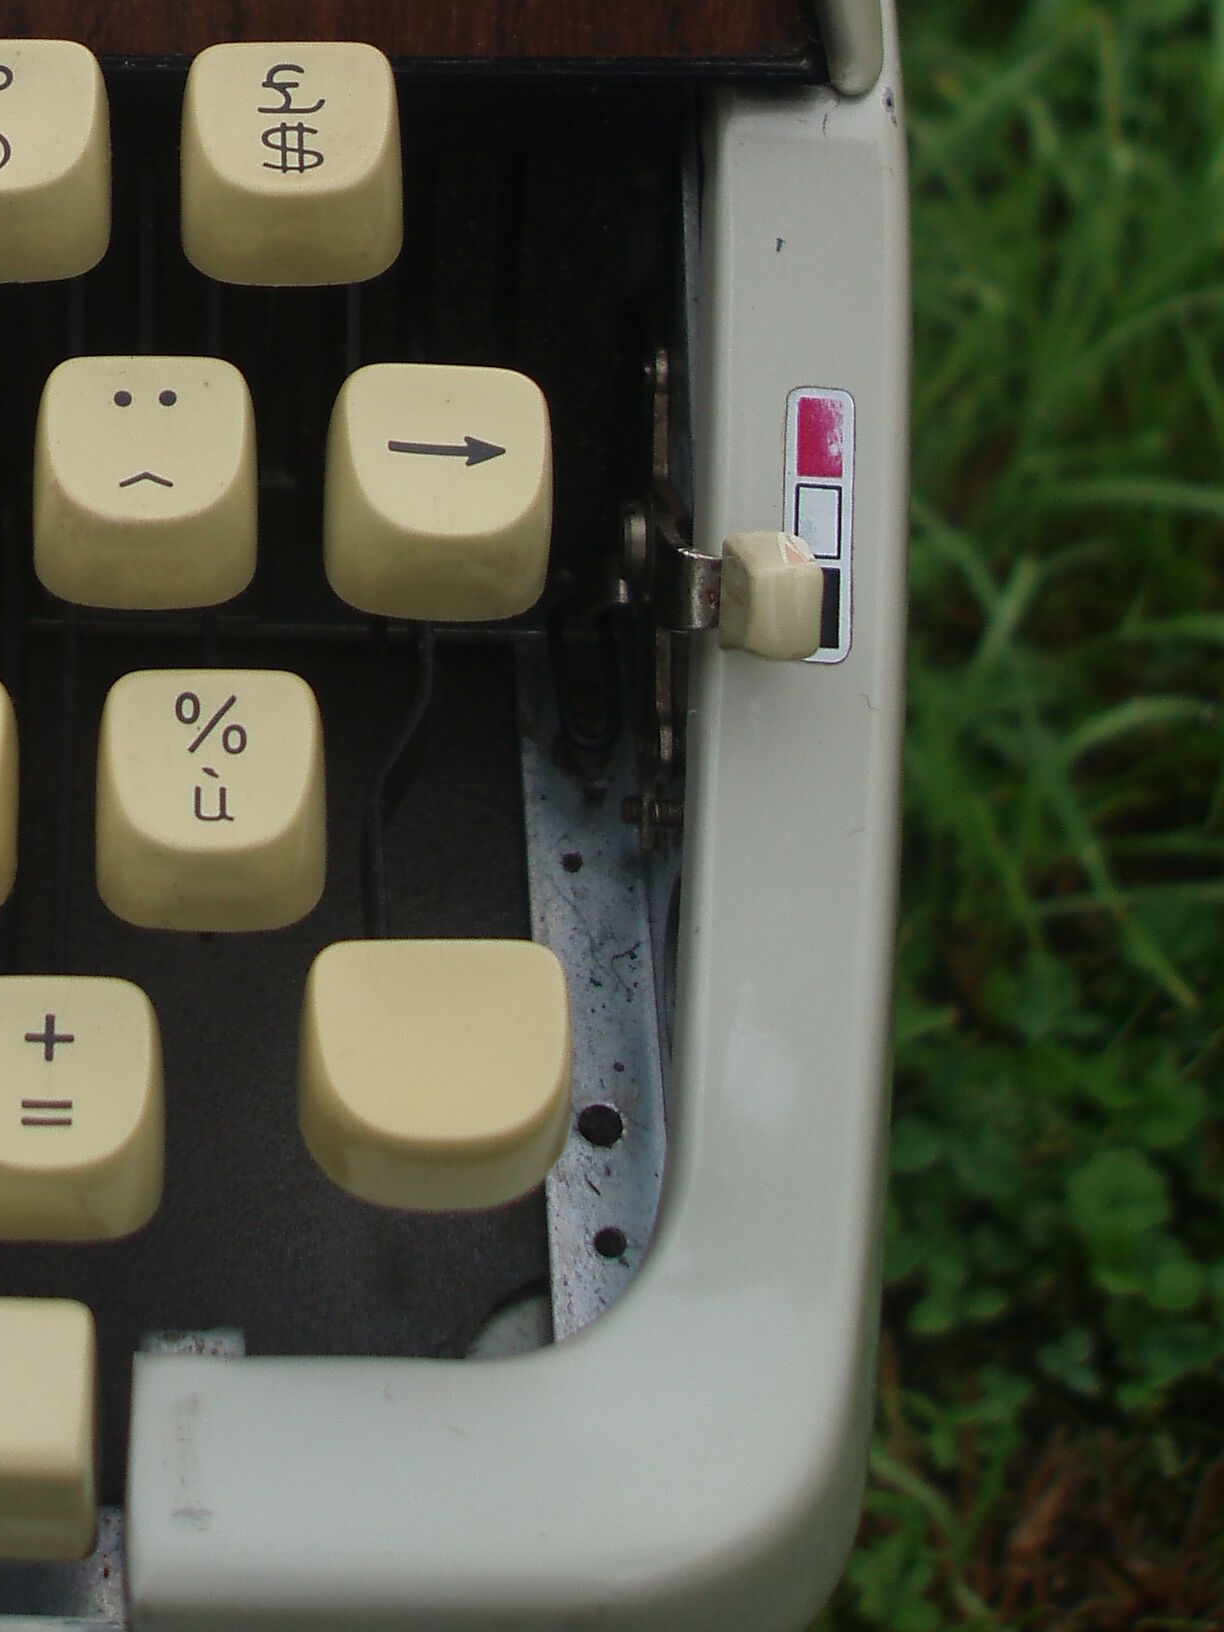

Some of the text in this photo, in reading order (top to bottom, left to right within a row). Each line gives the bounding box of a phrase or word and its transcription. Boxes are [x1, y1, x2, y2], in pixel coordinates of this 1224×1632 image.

[261, 121, 325, 174] $
[174, 691, 248, 755] %
[193, 767, 235, 822] ù
[24, 1013, 76, 1063] +
[20, 1099, 73, 1128] =
